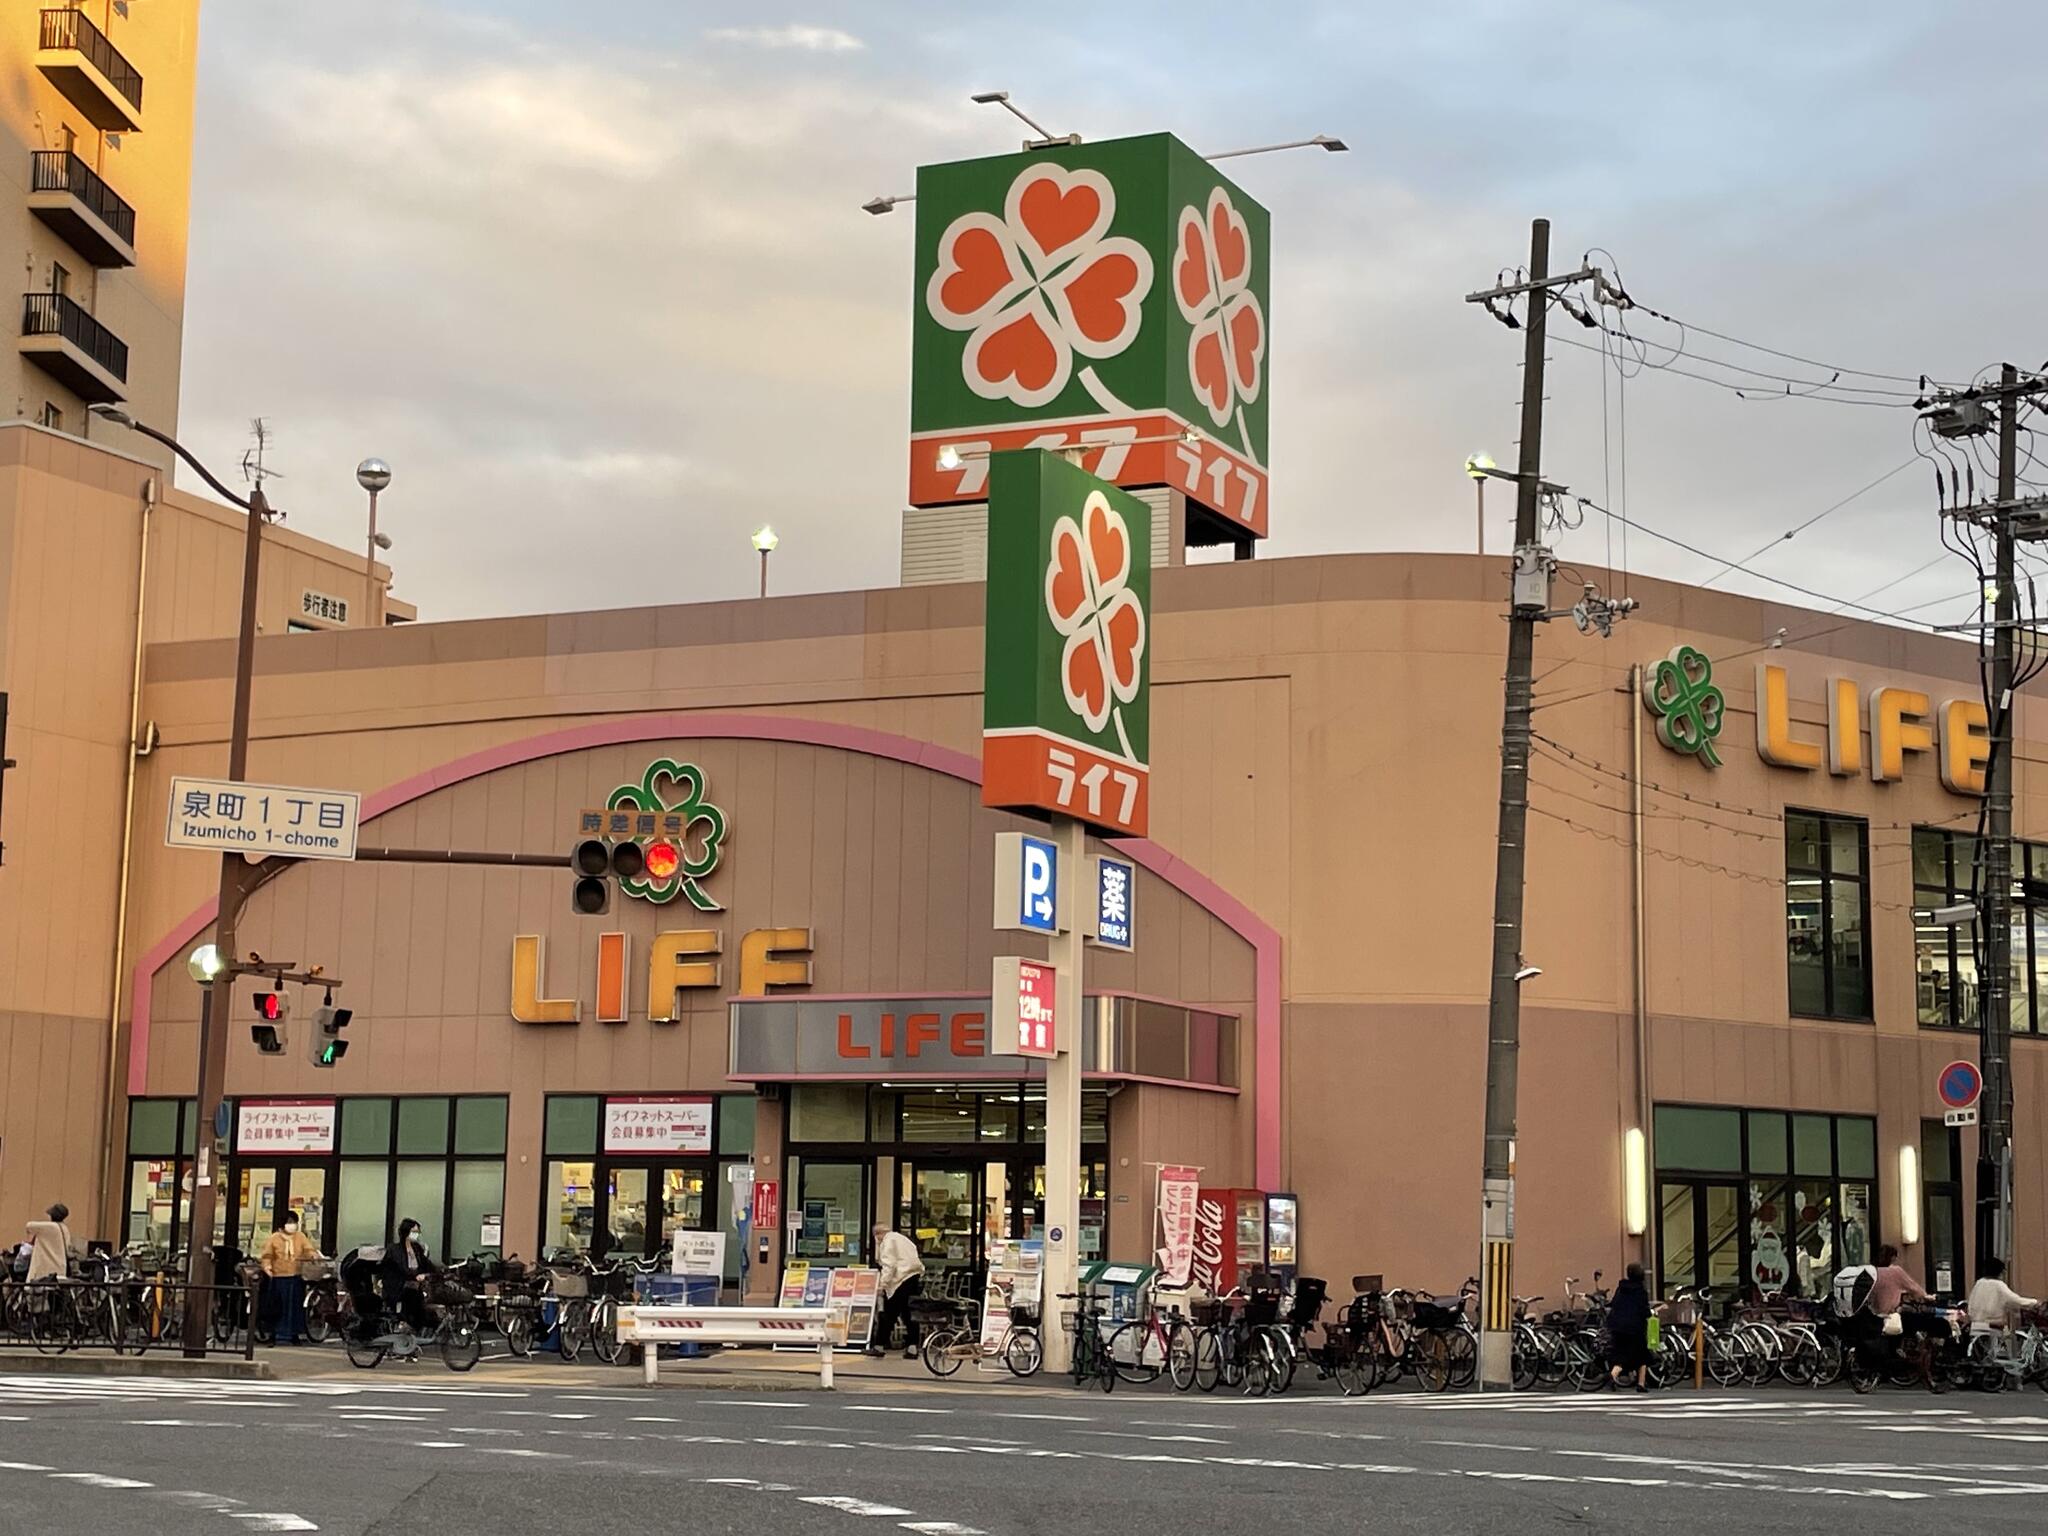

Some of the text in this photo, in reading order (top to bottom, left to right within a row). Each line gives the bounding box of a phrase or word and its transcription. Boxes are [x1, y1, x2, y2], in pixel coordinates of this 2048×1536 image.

[1177, 441, 1259, 522] ライフ
[304, 592, 346, 622] 歩行者注意
[1755, 664, 1991, 795] LIFE
[1047, 747, 1139, 825] ライフ
[183, 790, 345, 829] 泉町1丁目
[583, 812, 682, 835] 時差信号
[184, 822, 339, 849] Izumicho 1-chome
[1024, 845, 1050, 917] P
[1102, 867, 1126, 922] 薬
[511, 928, 814, 1024] LIFE
[838, 1012, 986, 1059] LIFE
[243, 1112, 324, 1124] ライフネットスーパー
[243, 1127, 294, 1140] 会員募集中
[611, 1110, 699, 1122] ライフネットスーパー
[611, 1126, 667, 1139] 会員募集中
